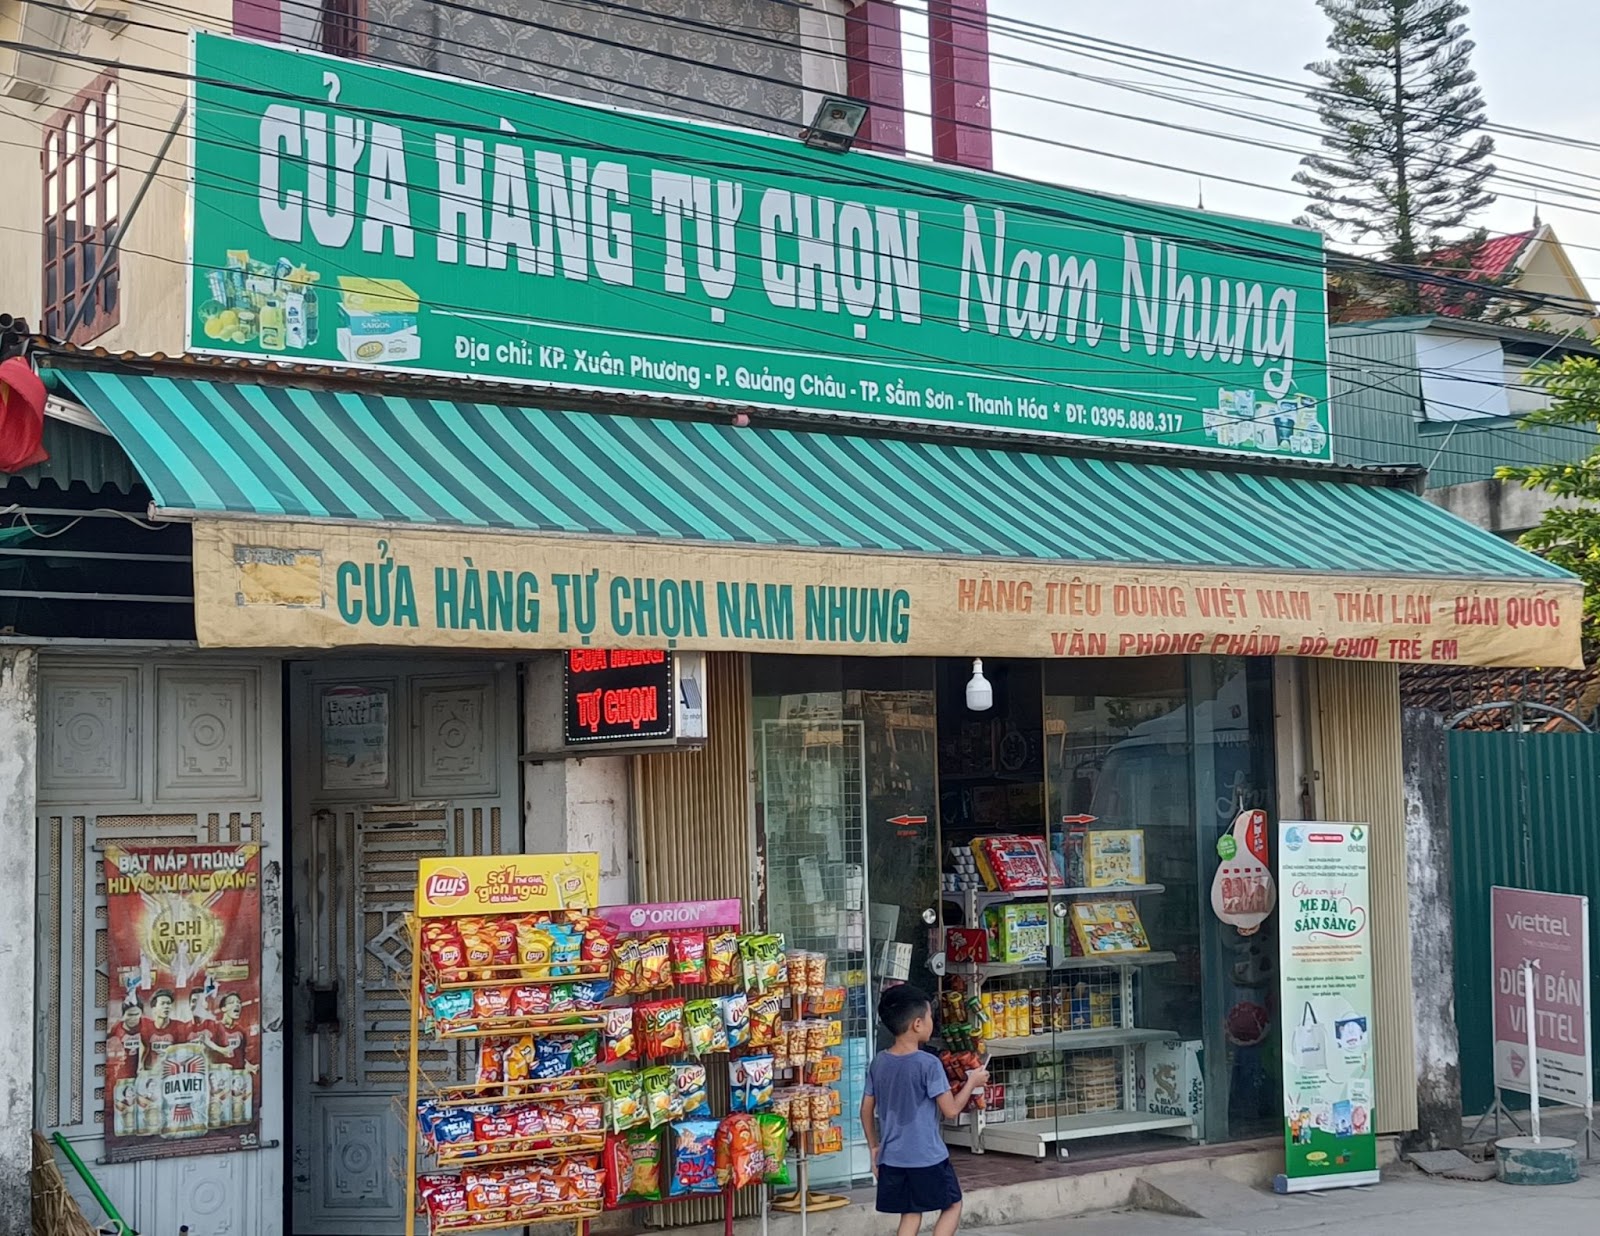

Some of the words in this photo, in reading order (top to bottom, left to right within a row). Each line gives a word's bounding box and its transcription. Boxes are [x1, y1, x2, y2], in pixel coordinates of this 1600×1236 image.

[259, 71, 415, 258] CỬA
[435, 118, 634, 287] HÀNG
[651, 169, 743, 323] TỰ
[759, 187, 922, 339] CHỌN
[957, 204, 1104, 347] Nam
[1119, 230, 1299, 399] Nhung
[455, 336, 489, 366] Địa
[496, 339, 533, 367] chỉ:
[539, 346, 567, 370] KP.
[573, 349, 625, 377] Xuân
[630, 355, 700, 389] Phương
[715, 365, 730, 387] P.
[735, 366, 795, 400] Quảng
[800, 373, 847, 399] Châu
[859, 380, 881, 403] TP.
[885, 378, 921, 408] Sầm
[925, 387, 954, 411] Sơn
[967, 392, 1013, 417] Thanh
[1017, 397, 1048, 420] Hóa
[1066, 402, 1087, 425] ĐT:
[1091, 404, 1183, 433] 0395.888.317
[336, 539, 420, 628] CỬA
[434, 557, 540, 633] HÀNG
[551, 568, 599, 645] TỰ
[609, 576, 708, 648] CHỌN
[716, 581, 794, 641] NAM
[804, 585, 911, 644] NHUNG
[957, 572, 1033, 615] HÀNG
[1045, 576, 1102, 617] TIÊU
[1113, 577, 1188, 618] DÙNG
[1195, 582, 1248, 624] VIỆT
[1256, 589, 1312, 621] NAM
[1391, 594, 1432, 625] LAN
[1454, 589, 1500, 626] HÀN
[1506, 589, 1561, 630] QUỐC
[1050, 628, 1106, 657] VĂN
[1118, 628, 1205, 657] PHÒNG
[1211, 625, 1281, 657] PHẨM
[1297, 627, 1329, 657] ĐỒ
[1332, 635, 1380, 659] CHƠI
[1388, 633, 1422, 661] TRẺ
[1431, 639, 1458, 661] EM
[576, 688, 602, 733] TỰ
[604, 685, 658, 730] CHỌN
[191, 851, 245, 870] TRÚNG
[108, 877, 140, 894] HUY
[429, 874, 467, 897] Lay's
[488, 872, 505, 884] Số
[506, 865, 516, 884] 1
[513, 885, 547, 901] ngon
[651, 909, 700, 924] ORION
[1300, 898, 1318, 915] MẸ
[160, 922, 170, 937] 2
[1506, 911, 1571, 937] viettel
[1545, 970, 1582, 1007] BÁN
[1510, 1004, 1578, 1044] VITTEL
[165, 1081, 181, 1095] BIA
[183, 1076, 203, 1094] VIỆT
[1149, 1103, 1187, 1117] SAIGON
